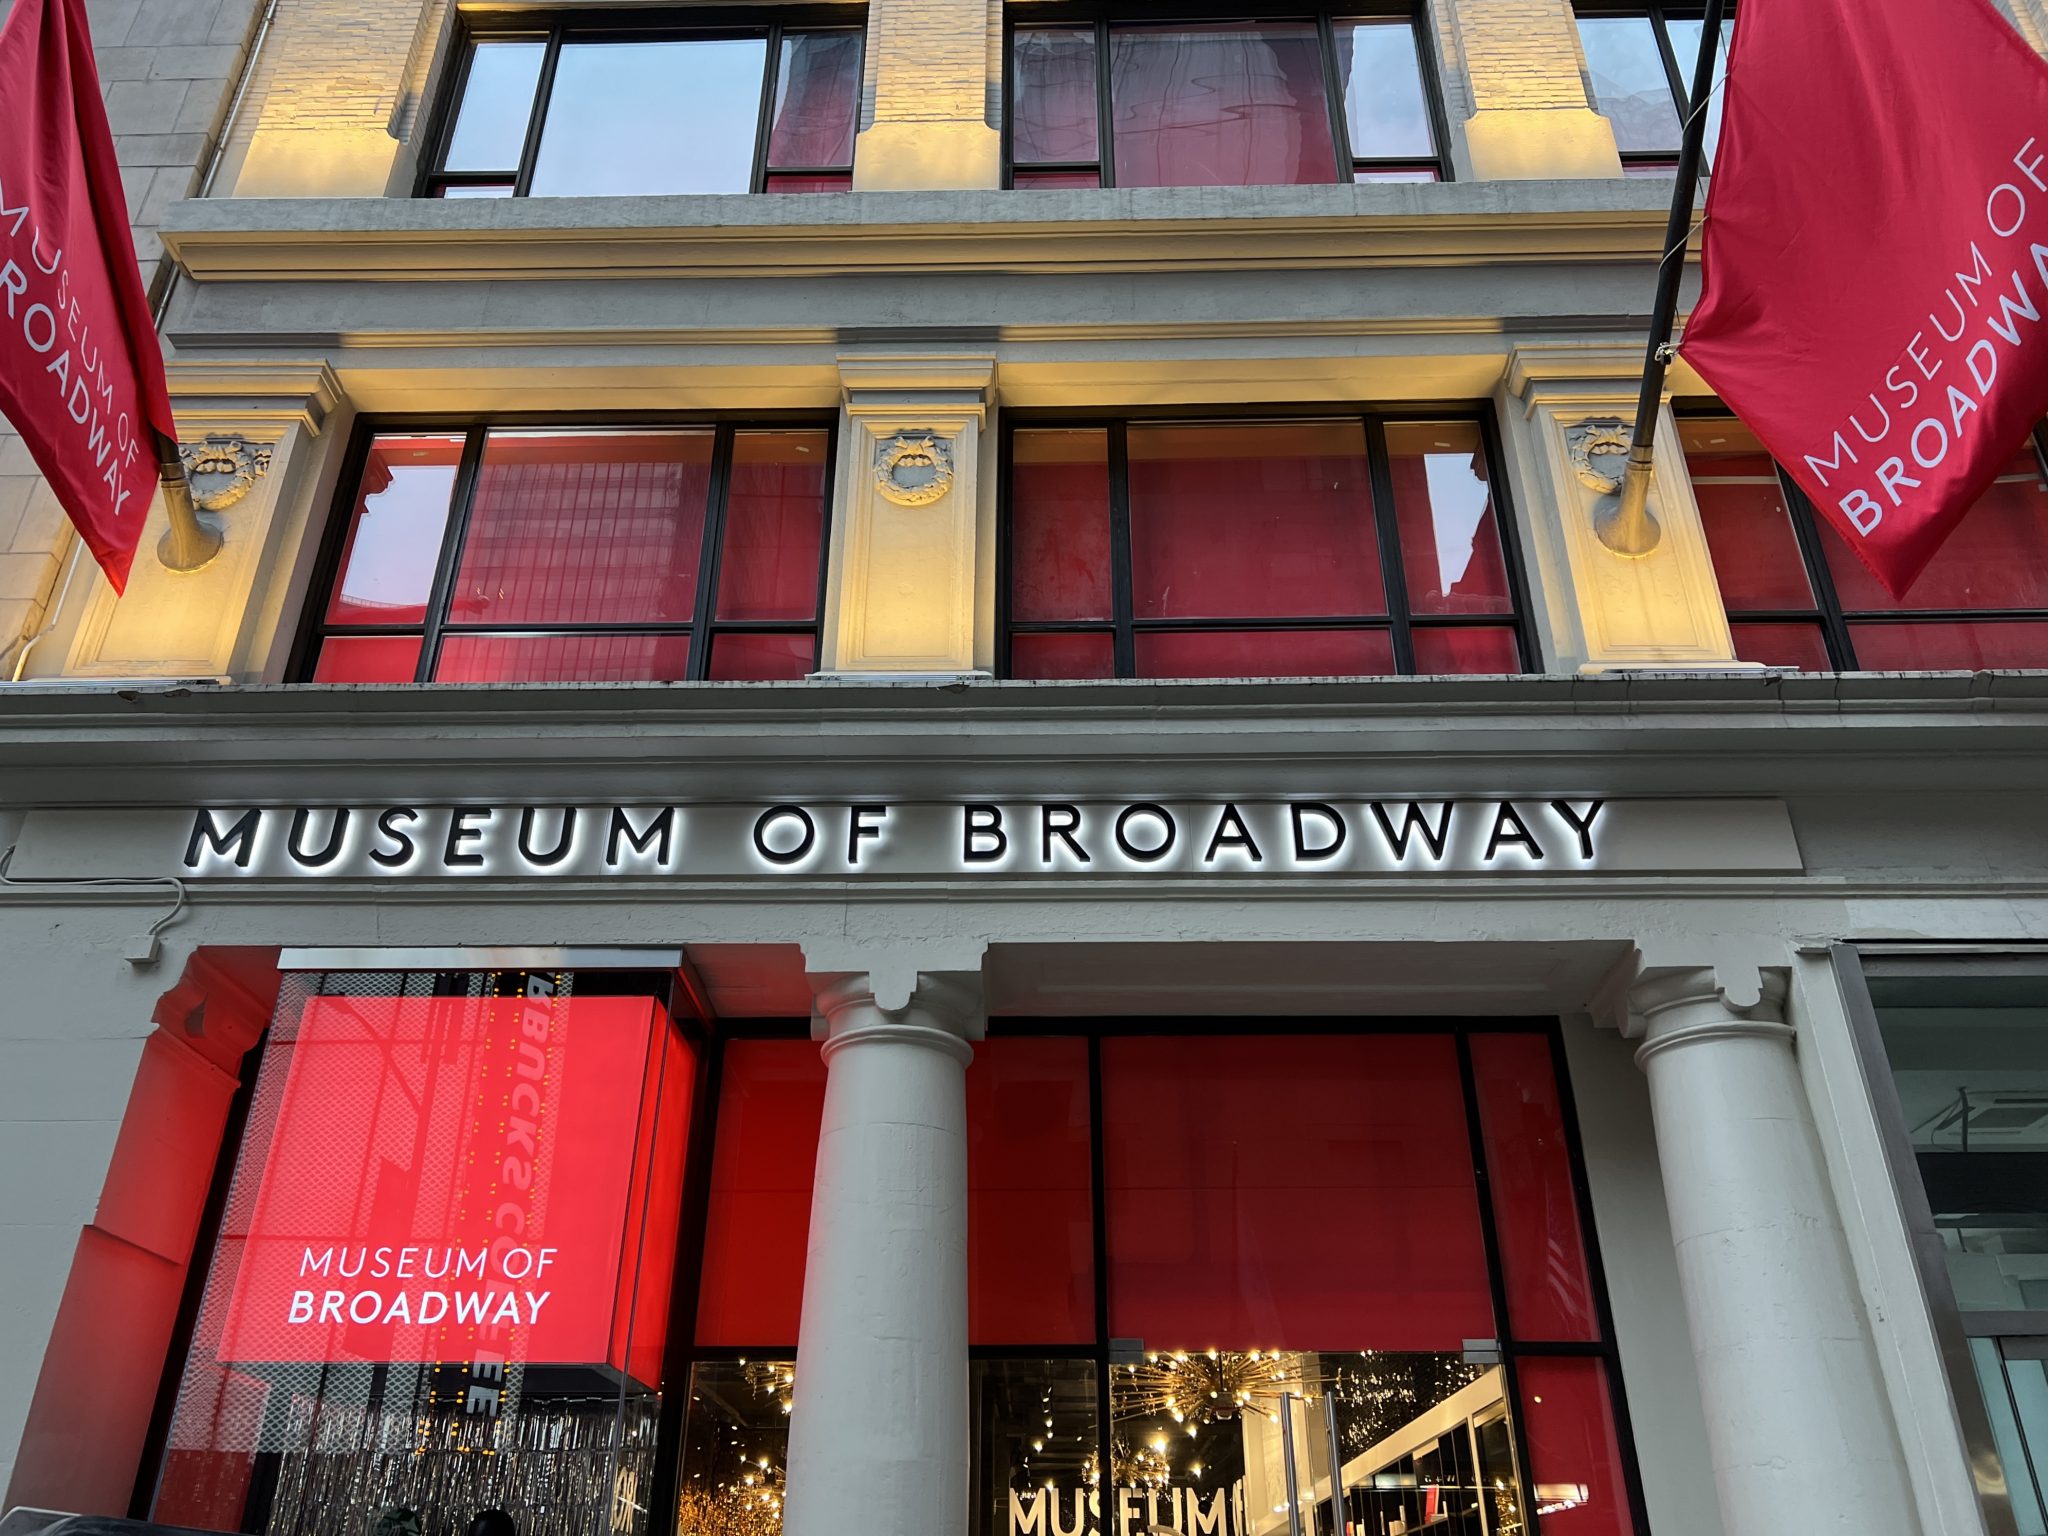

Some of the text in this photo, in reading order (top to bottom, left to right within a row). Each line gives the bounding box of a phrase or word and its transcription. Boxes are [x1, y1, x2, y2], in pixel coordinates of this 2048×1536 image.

[0, 180, 139, 468] MUSEUM OF
[1804, 136, 2048, 487] MUSEUM OF
[184, 801, 1605, 869] MUSEUM OF BROADWAY
[299, 1247, 558, 1279] MUSEUM OF
[287, 1290, 551, 1325] BROADWAY
